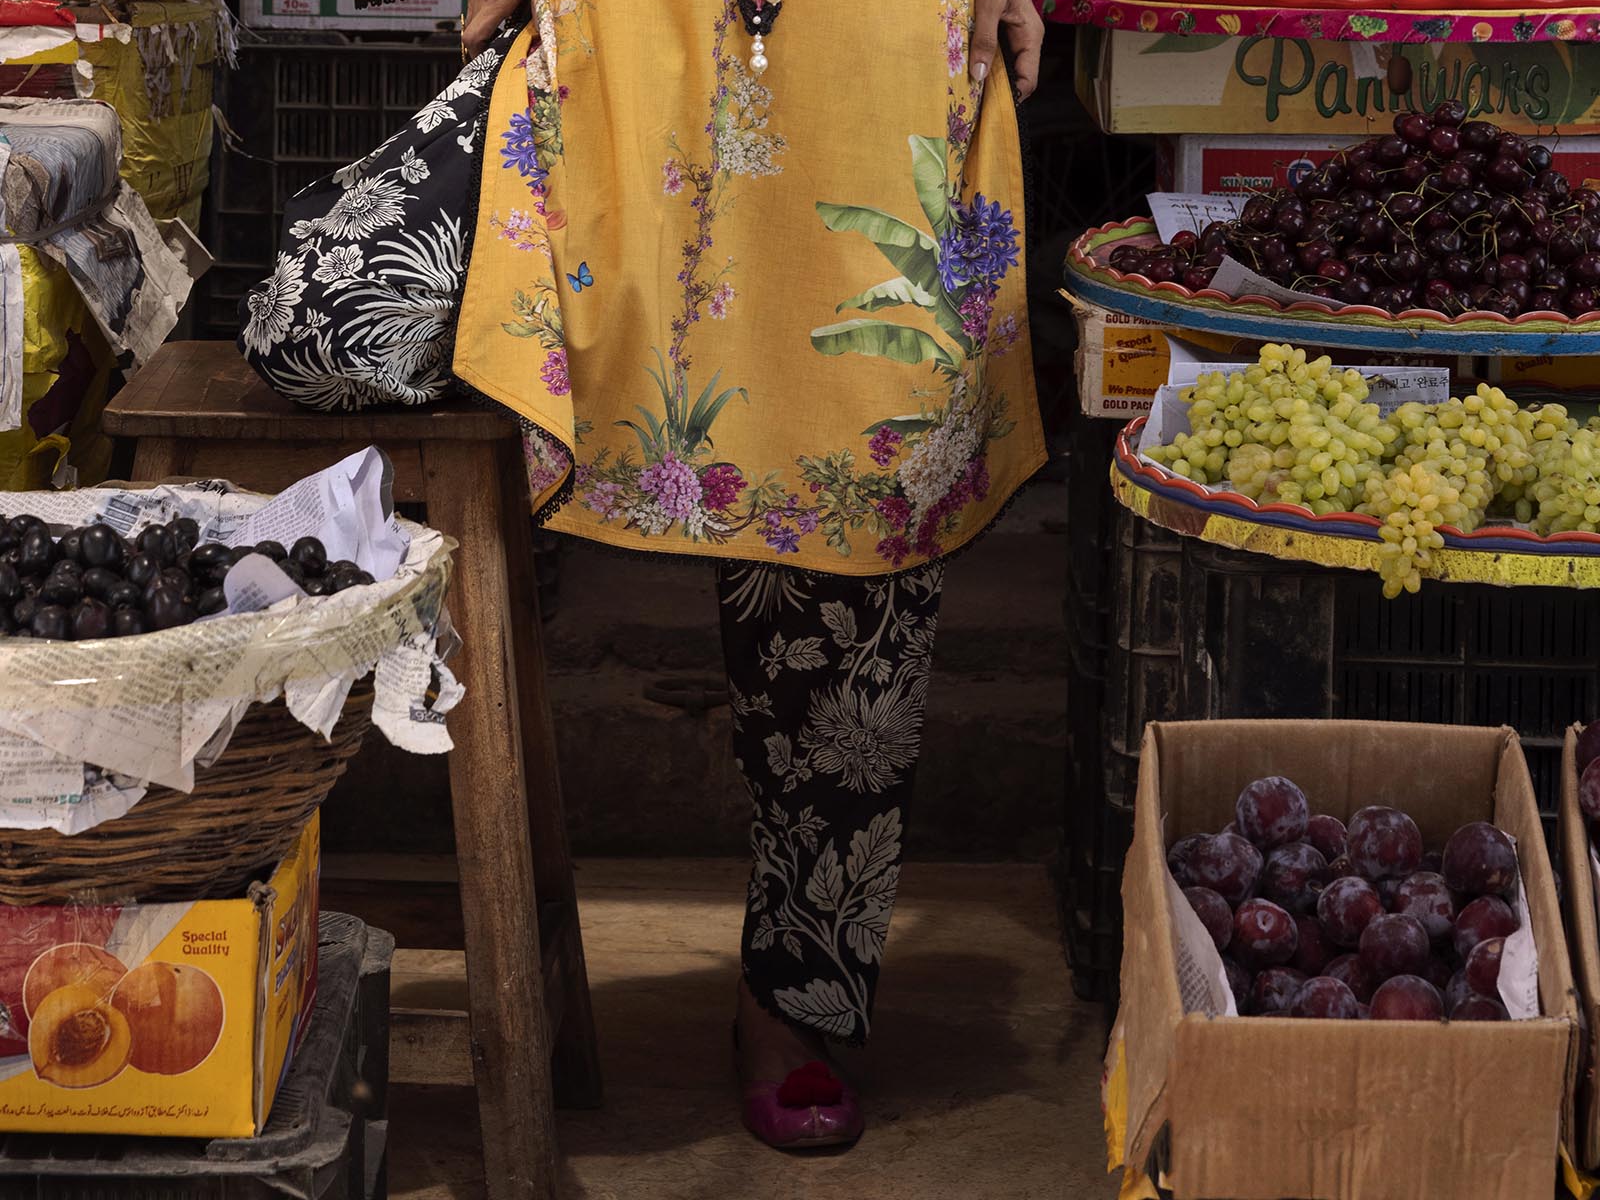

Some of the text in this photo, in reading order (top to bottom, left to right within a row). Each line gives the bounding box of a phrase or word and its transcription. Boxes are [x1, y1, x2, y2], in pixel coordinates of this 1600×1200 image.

[1105, 313, 1130, 324] GOLD
[1103, 399, 1128, 409] GOLD
[182, 930, 226, 943] Special
[182, 943, 230, 956] Quality
